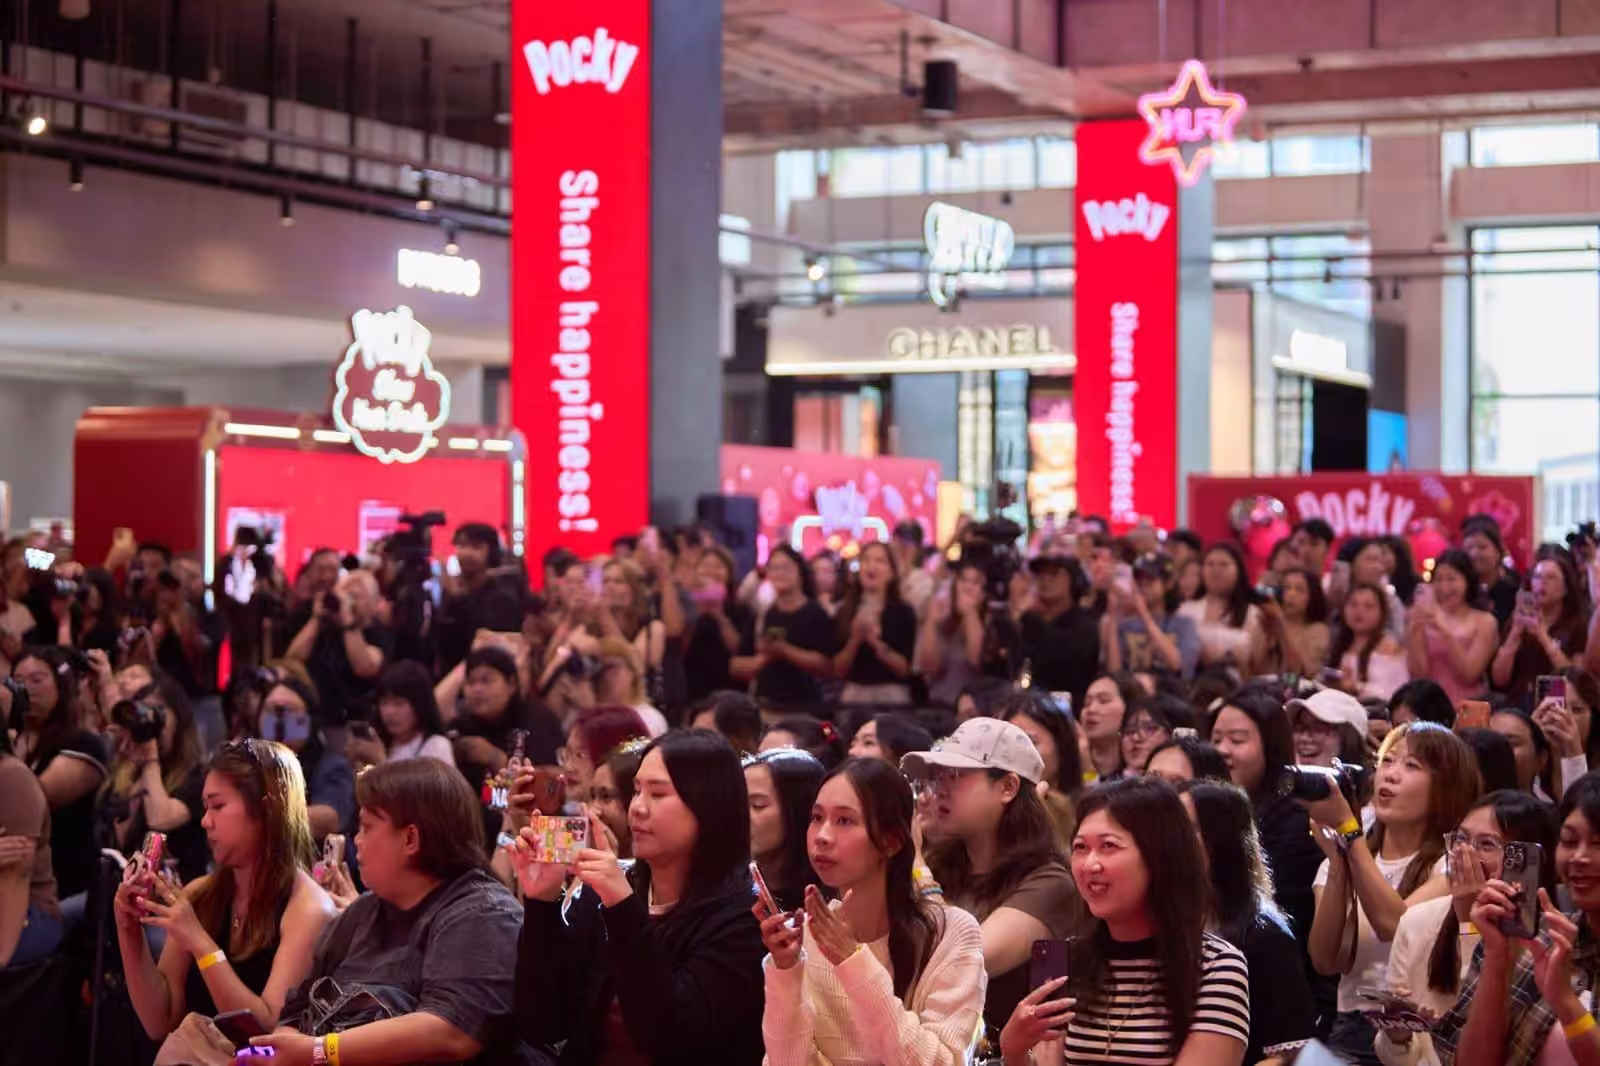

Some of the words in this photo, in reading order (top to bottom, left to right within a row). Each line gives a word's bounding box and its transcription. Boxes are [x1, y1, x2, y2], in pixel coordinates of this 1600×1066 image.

[523, 26, 639, 95] Pocky
[559, 169, 599, 292] Share
[886, 322, 1056, 360] CHANEL
[1110, 301, 1140, 379] Share
[550, 301, 604, 532] happiness!
